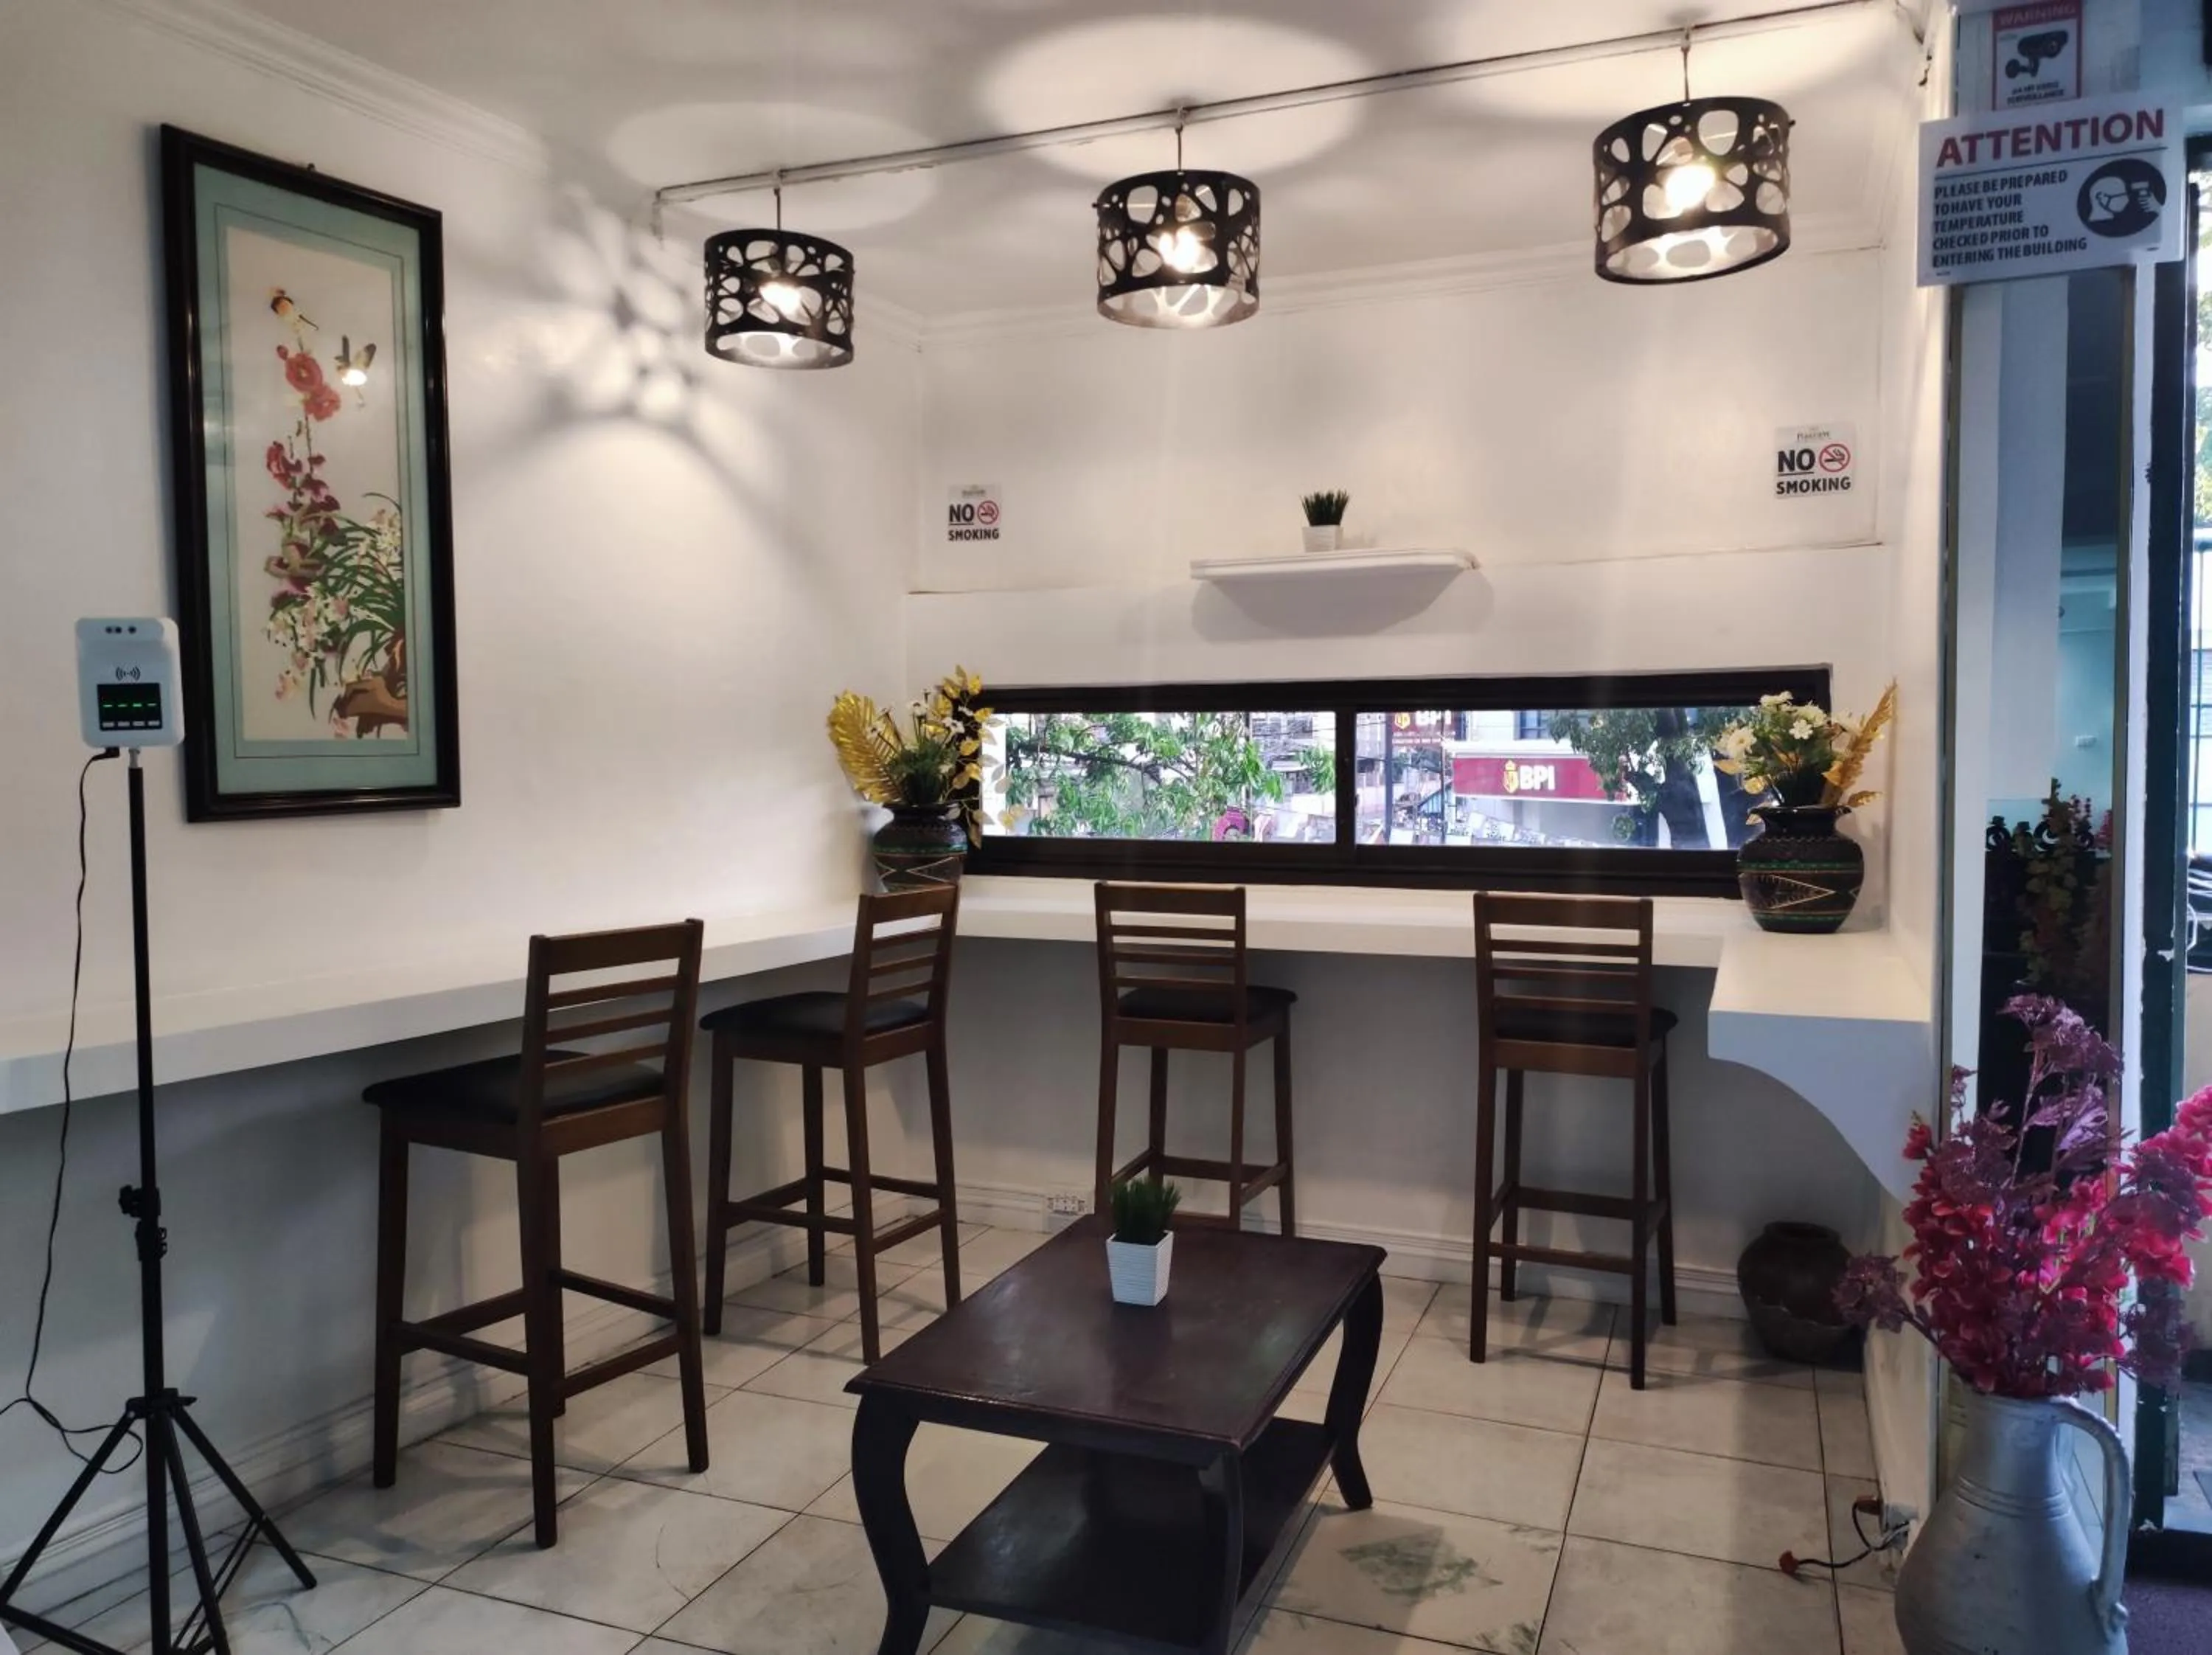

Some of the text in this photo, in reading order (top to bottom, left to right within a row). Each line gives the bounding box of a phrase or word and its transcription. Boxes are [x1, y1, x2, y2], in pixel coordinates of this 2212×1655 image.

[2000, 4, 2076, 27] WARNING
[1935, 108, 2164, 169] ATTENTION
[1934, 170, 2068, 200] PLEASE BE PREPARED
[1934, 193, 2023, 216] TO HAVE YOUR
[1933, 210, 2025, 234] TEMPERATURE
[1933, 224, 2049, 251] CHECKED PRIOR TO
[1932, 237, 2087, 268] ENTERING THE BUILDING
[1778, 448, 1815, 473] NO
[1776, 476, 1851, 495] SMOKING
[949, 503, 975, 522] NO
[948, 527, 1000, 541] SMOKING
[1520, 765, 1556, 790] BPI
